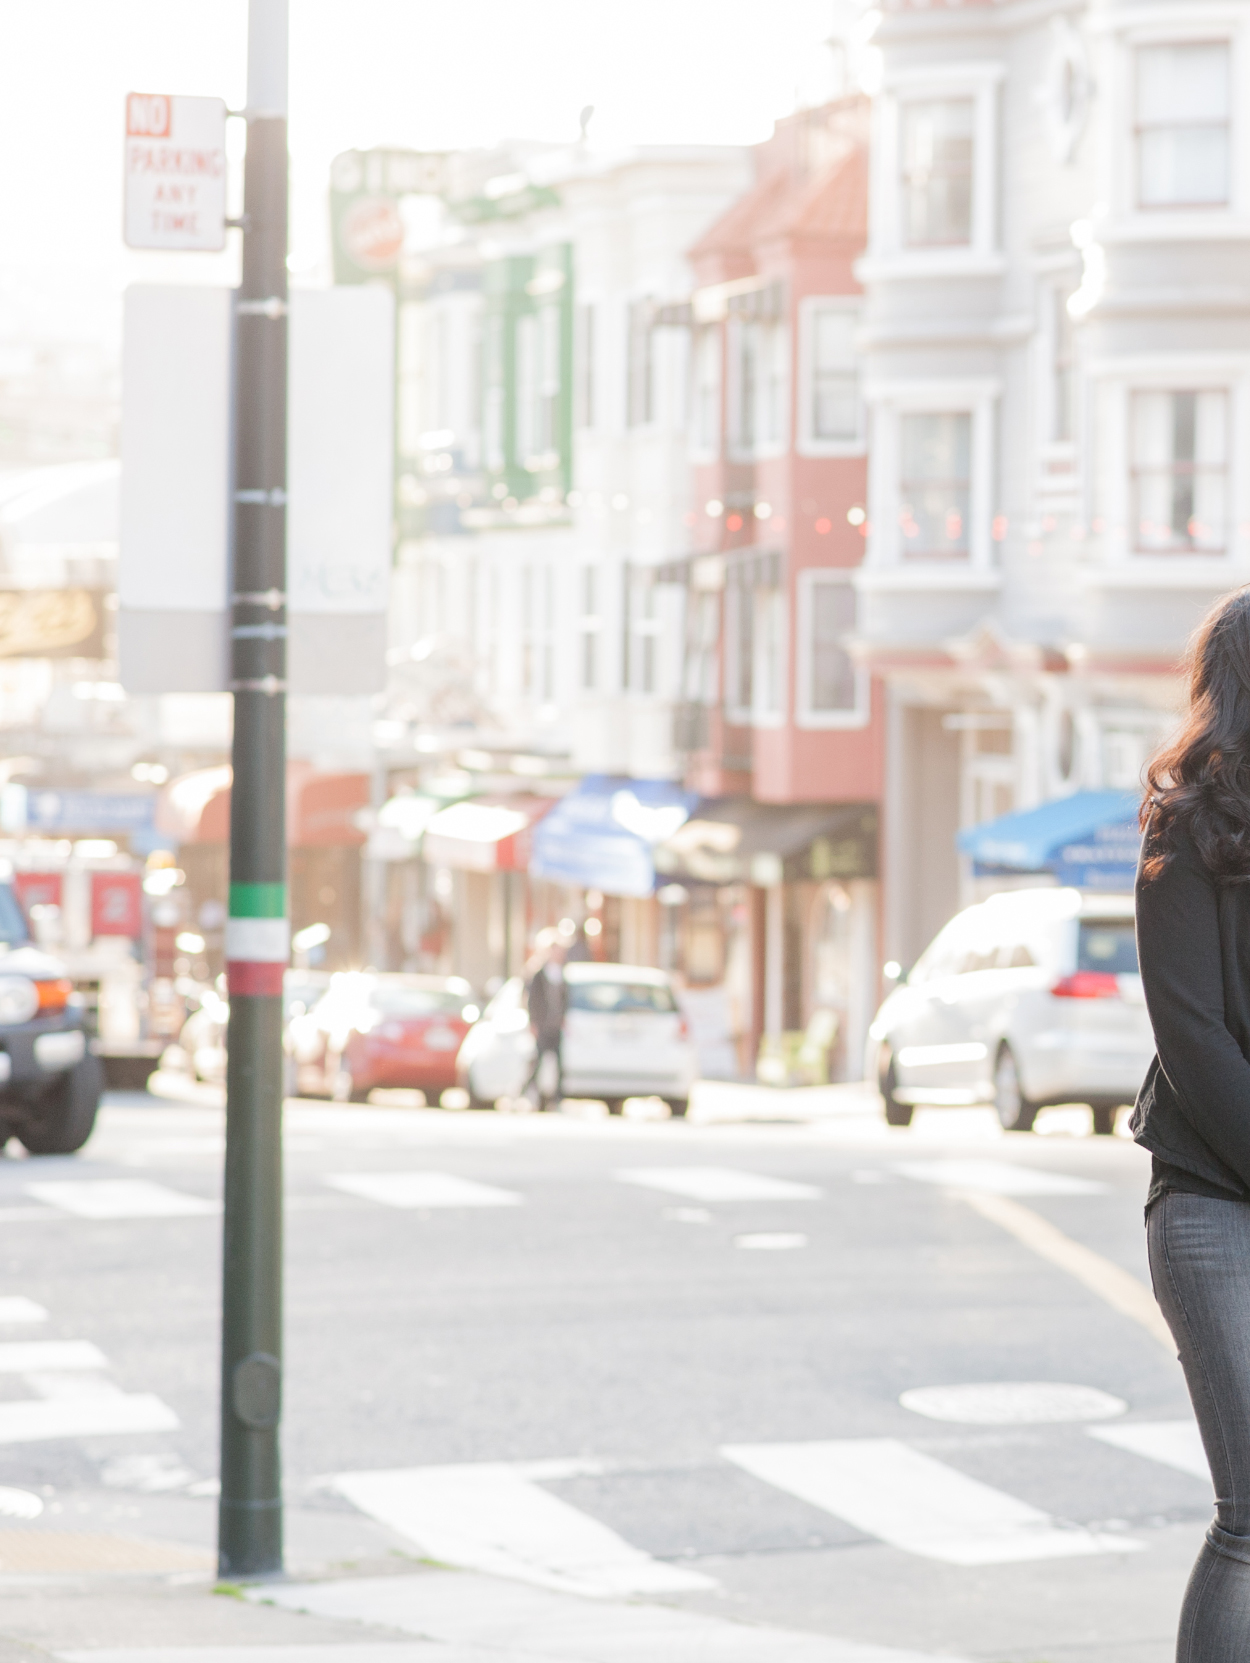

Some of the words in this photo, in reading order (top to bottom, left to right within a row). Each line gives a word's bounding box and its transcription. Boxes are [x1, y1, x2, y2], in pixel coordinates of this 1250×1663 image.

[130, 98, 166, 133] NO
[131, 146, 221, 179] PARKING
[153, 183, 197, 205] ANY
[151, 209, 199, 236] TIME
